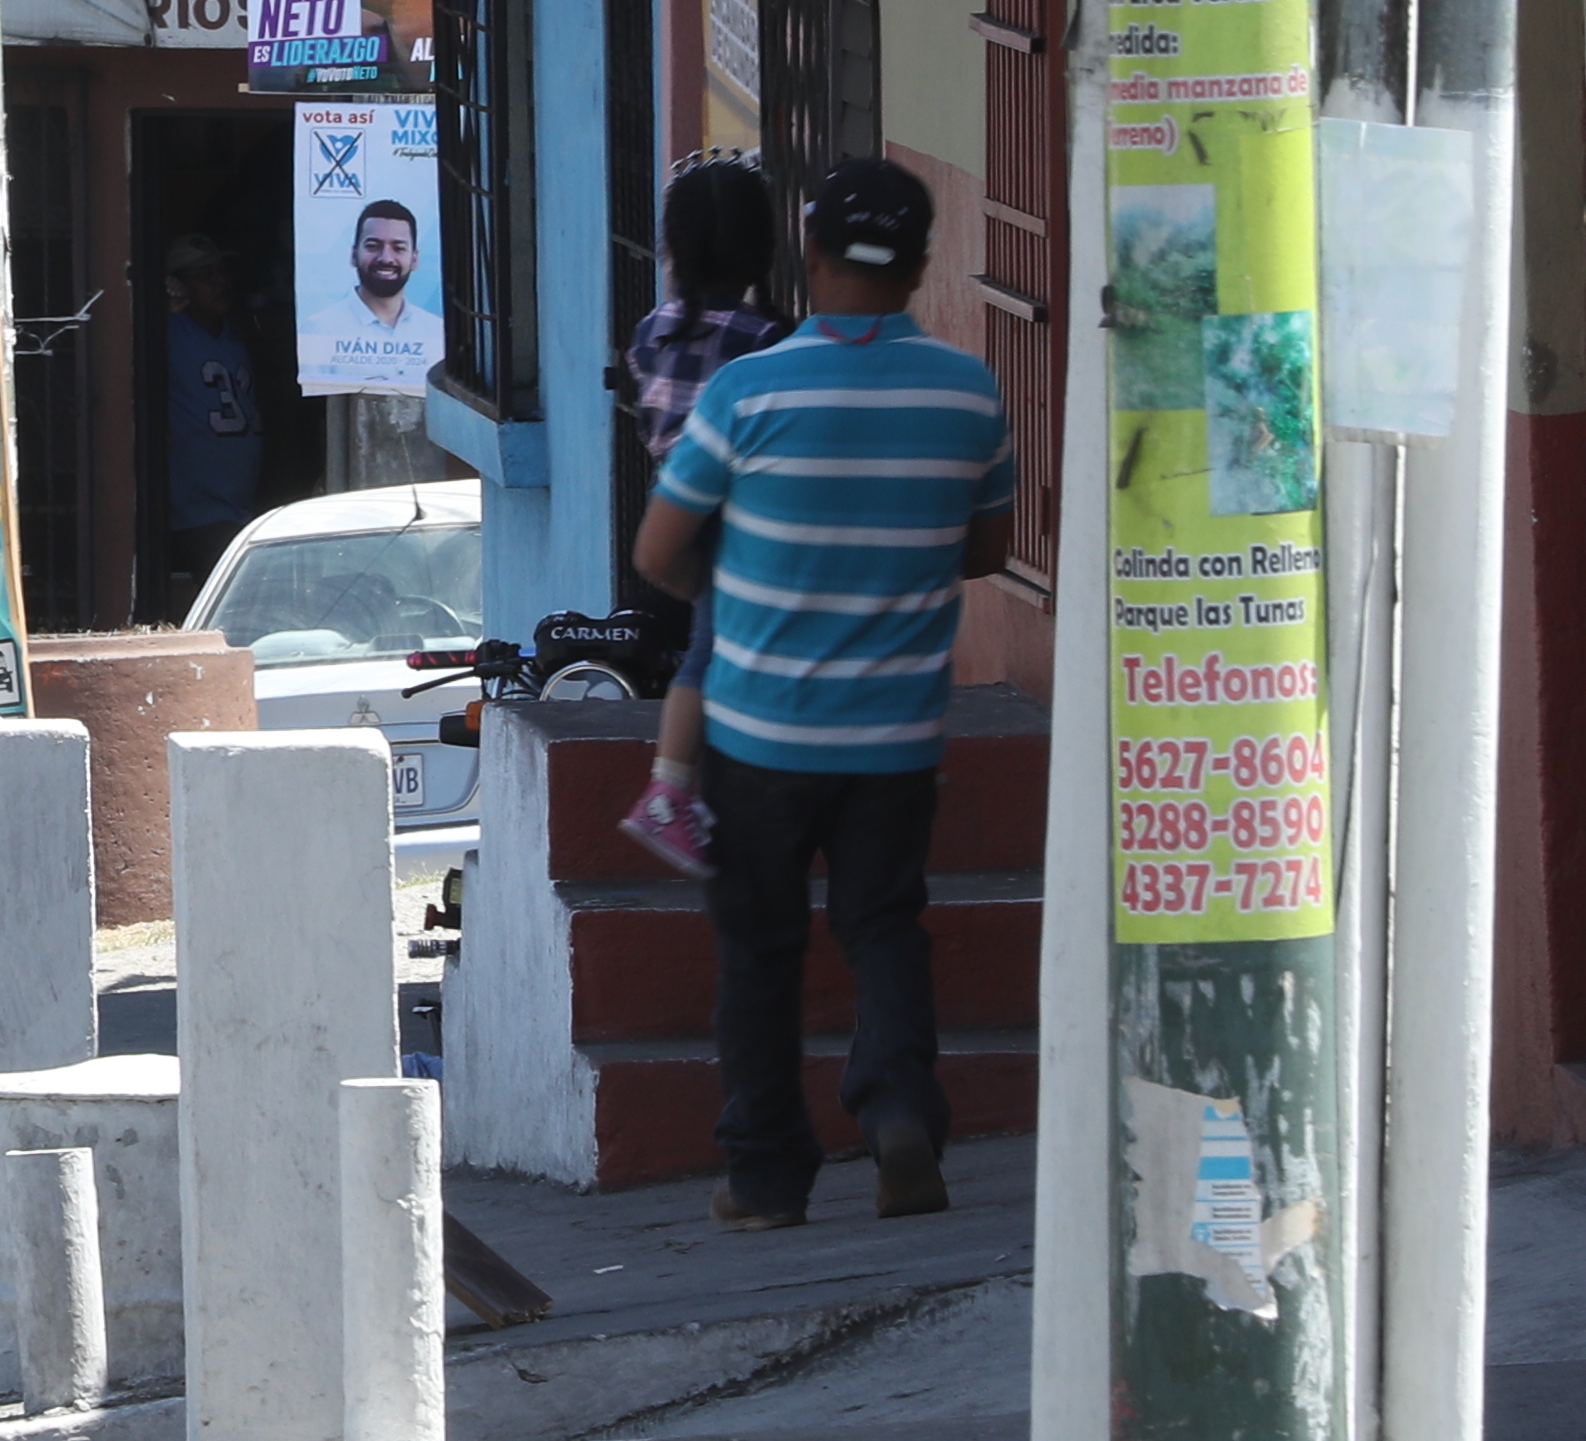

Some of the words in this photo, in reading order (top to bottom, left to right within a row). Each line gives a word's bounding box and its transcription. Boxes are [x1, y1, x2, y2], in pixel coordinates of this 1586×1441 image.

[253, 45, 271, 63] ES
[271, 36, 381, 68] LIDERAZGO
[1167, 70, 1283, 99] manzana
[302, 110, 342, 124] vota
[348, 109, 375, 124] así
[313, 173, 362, 190] VIVA
[335, 337, 379, 356] IVÁN
[383, 341, 424, 356] DIAZ
[1115, 546, 1191, 579] Colinda
[1198, 555, 1244, 578] con
[1251, 544, 1322, 576] Relleno
[1115, 596, 1189, 632] Parque
[1197, 595, 1233, 627] las
[1239, 594, 1305, 626] Tunas
[549, 624, 641, 643] CARMEN
[1122, 654, 1319, 706] Telefonos:
[1118, 732, 1325, 791] 5627-8604
[1120, 794, 1324, 852] 3288-8590
[1121, 855, 1323, 914] 4337-7274
